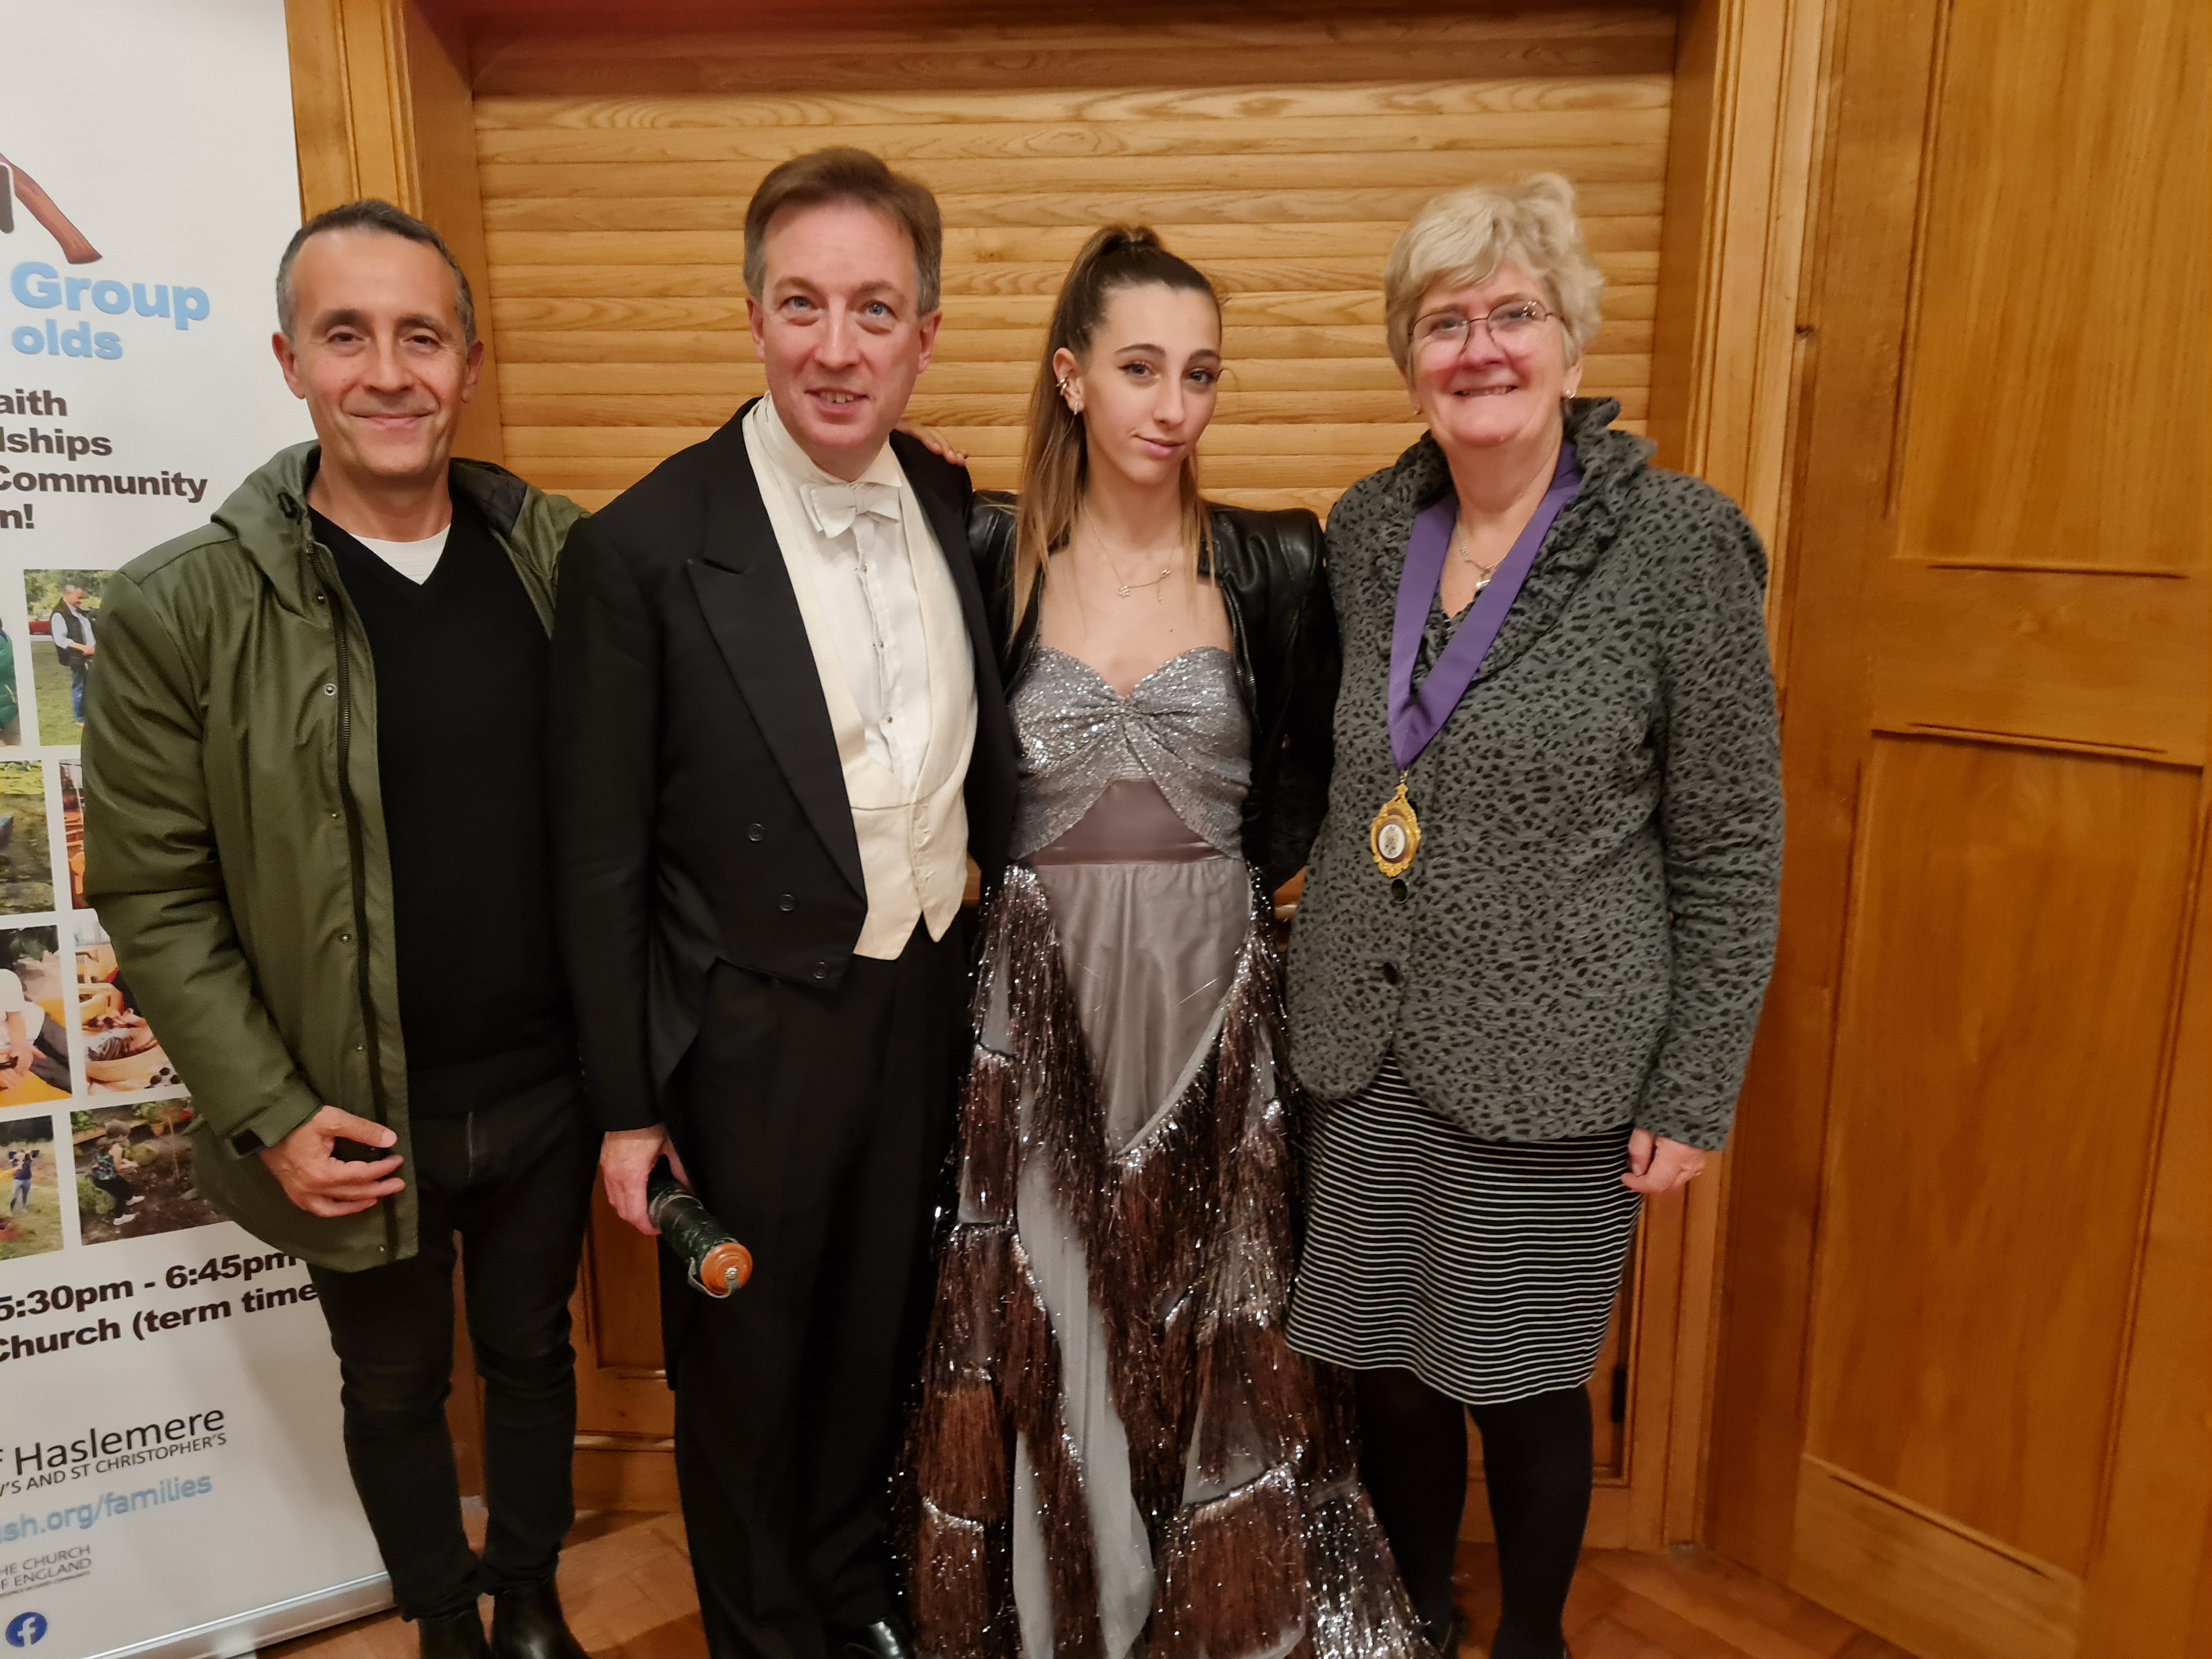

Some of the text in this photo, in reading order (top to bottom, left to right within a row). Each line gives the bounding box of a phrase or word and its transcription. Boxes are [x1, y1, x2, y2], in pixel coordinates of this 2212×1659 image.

[10, 261, 210, 330] Group
[12, 319, 123, 360] olds
[0, 426, 112, 461] ships
[0, 1280, 133, 1322] 5:30pm
[166, 1252, 296, 1289] 6:45pm
[133, 1300, 231, 1340] (term
[241, 1283, 319, 1313] time
[15, 1410, 224, 1476] Haslemere
[26, 1470, 65, 1490] AND
[71, 1463, 91, 1480] ST
[96, 1432, 227, 1473] CHRISTOPHER'S
[14, 1558, 92, 1586] ENGLAND
[22, 1544, 91, 1570] CHURCH
